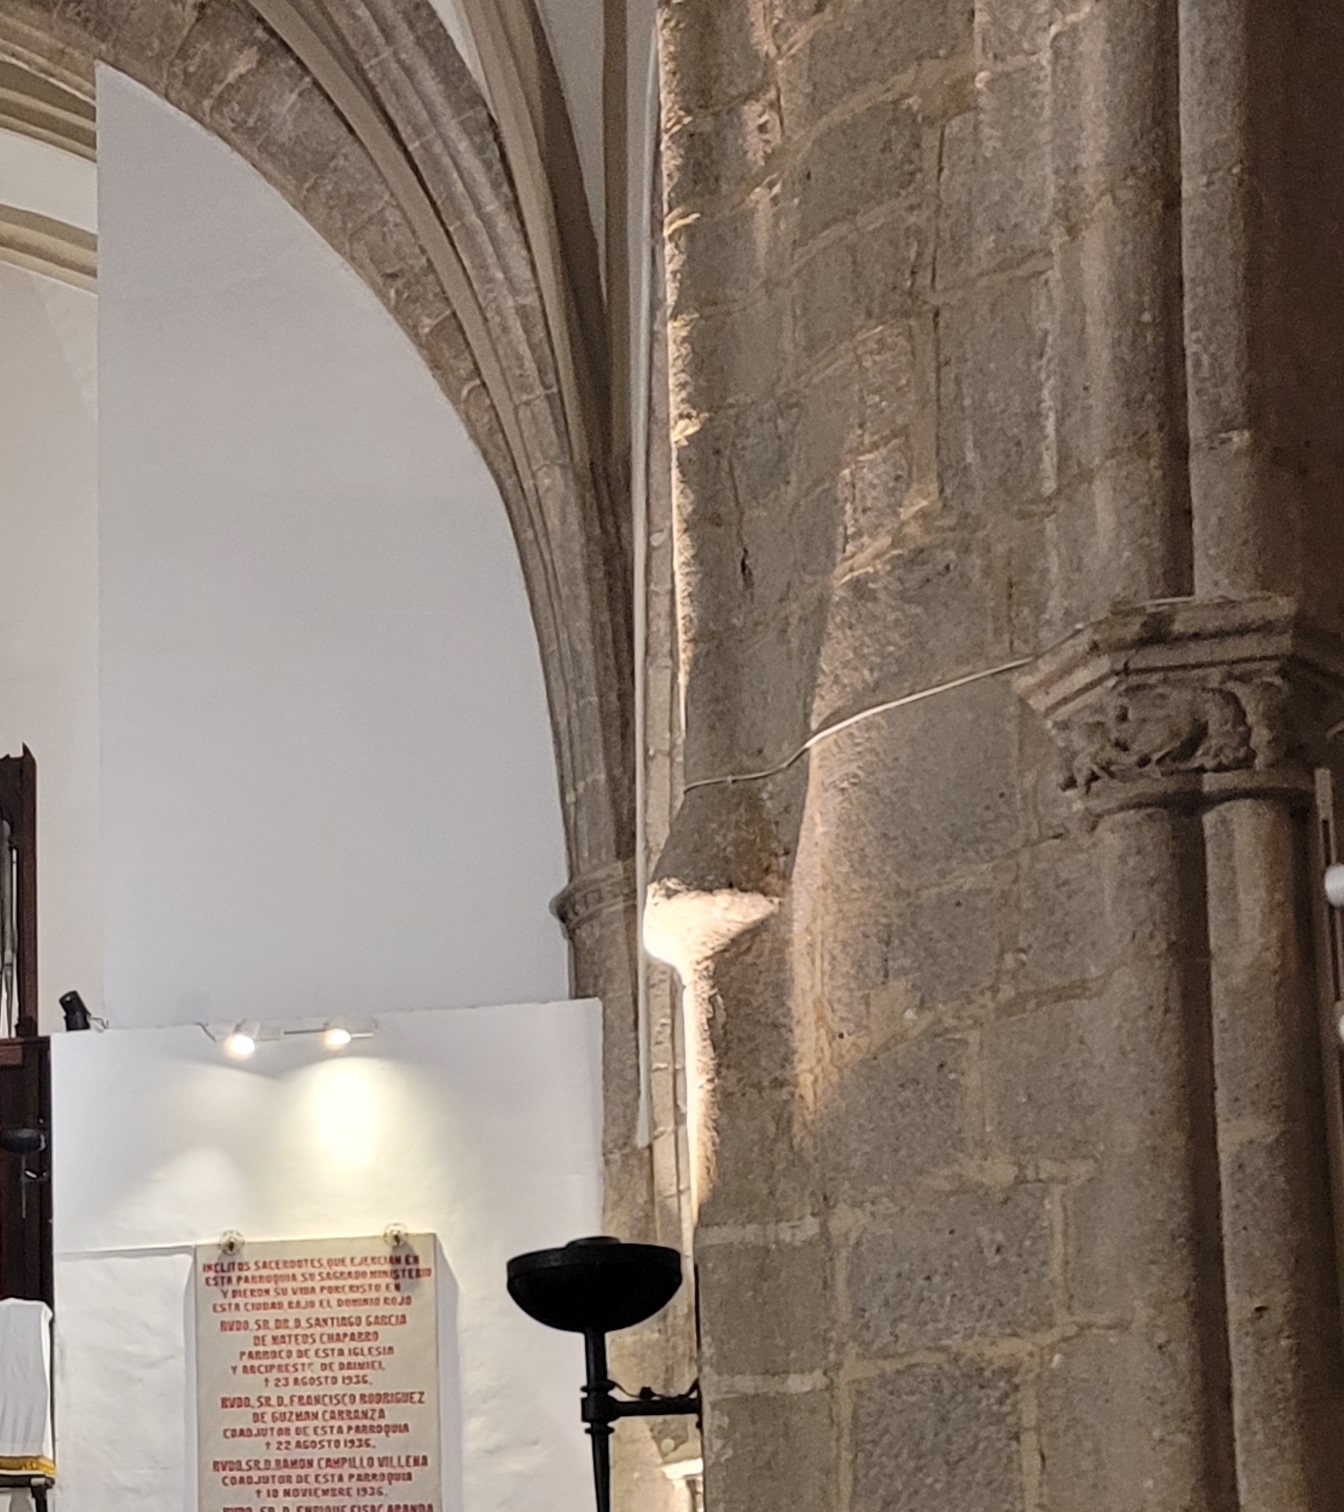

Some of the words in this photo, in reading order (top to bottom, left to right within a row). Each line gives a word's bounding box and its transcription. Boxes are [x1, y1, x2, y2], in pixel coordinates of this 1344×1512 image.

[205, 1277, 233, 1287] ESTA
[318, 1271, 367, 1283] SAGRADO
[232, 1288, 270, 1299] DIERON
[213, 1303, 240, 1314] ESTA
[383, 1296, 412, 1307] ROJO
[306, 1315, 362, 1329] SANTIAGO
[365, 1314, 406, 1327] GARCIA
[253, 1335, 267, 1346] DE
[271, 1333, 316, 1346] MATEOS
[320, 1331, 379, 1344] CHAPARRO
[240, 1349, 292, 1361] PARROCO
[314, 1347, 345, 1359] ESTA
[348, 1346, 394, 1357] IGLESIA
[274, 1377, 289, 1388] 23
[293, 1376, 338, 1387] AGOSTO
[290, 1393, 356, 1408] FRANCISCO
[359, 1391, 425, 1405] RODRIGUEZ
[252, 1411, 267, 1424] DE
[271, 1410, 318, 1423] GUZMAN
[322, 1408, 385, 1422] CARRANZA
[223, 1427, 291, 1439] COADJUTOR
[313, 1425, 344, 1437] ESTA
[347, 1423, 409, 1438] PARROQUIA
[276, 1441, 291, 1451] 22
[295, 1439, 340, 1450] AGOSTO
[317, 1456, 374, 1470] CAMPILLO
[377, 1455, 428, 1468] VILLENA
[222, 1474, 292, 1486] COADJUTOR
[314, 1473, 344, 1484] ESTA
[348, 1471, 412, 1486] PARROQUIA
[283, 1487, 352, 1499] NOVIEMBRE
